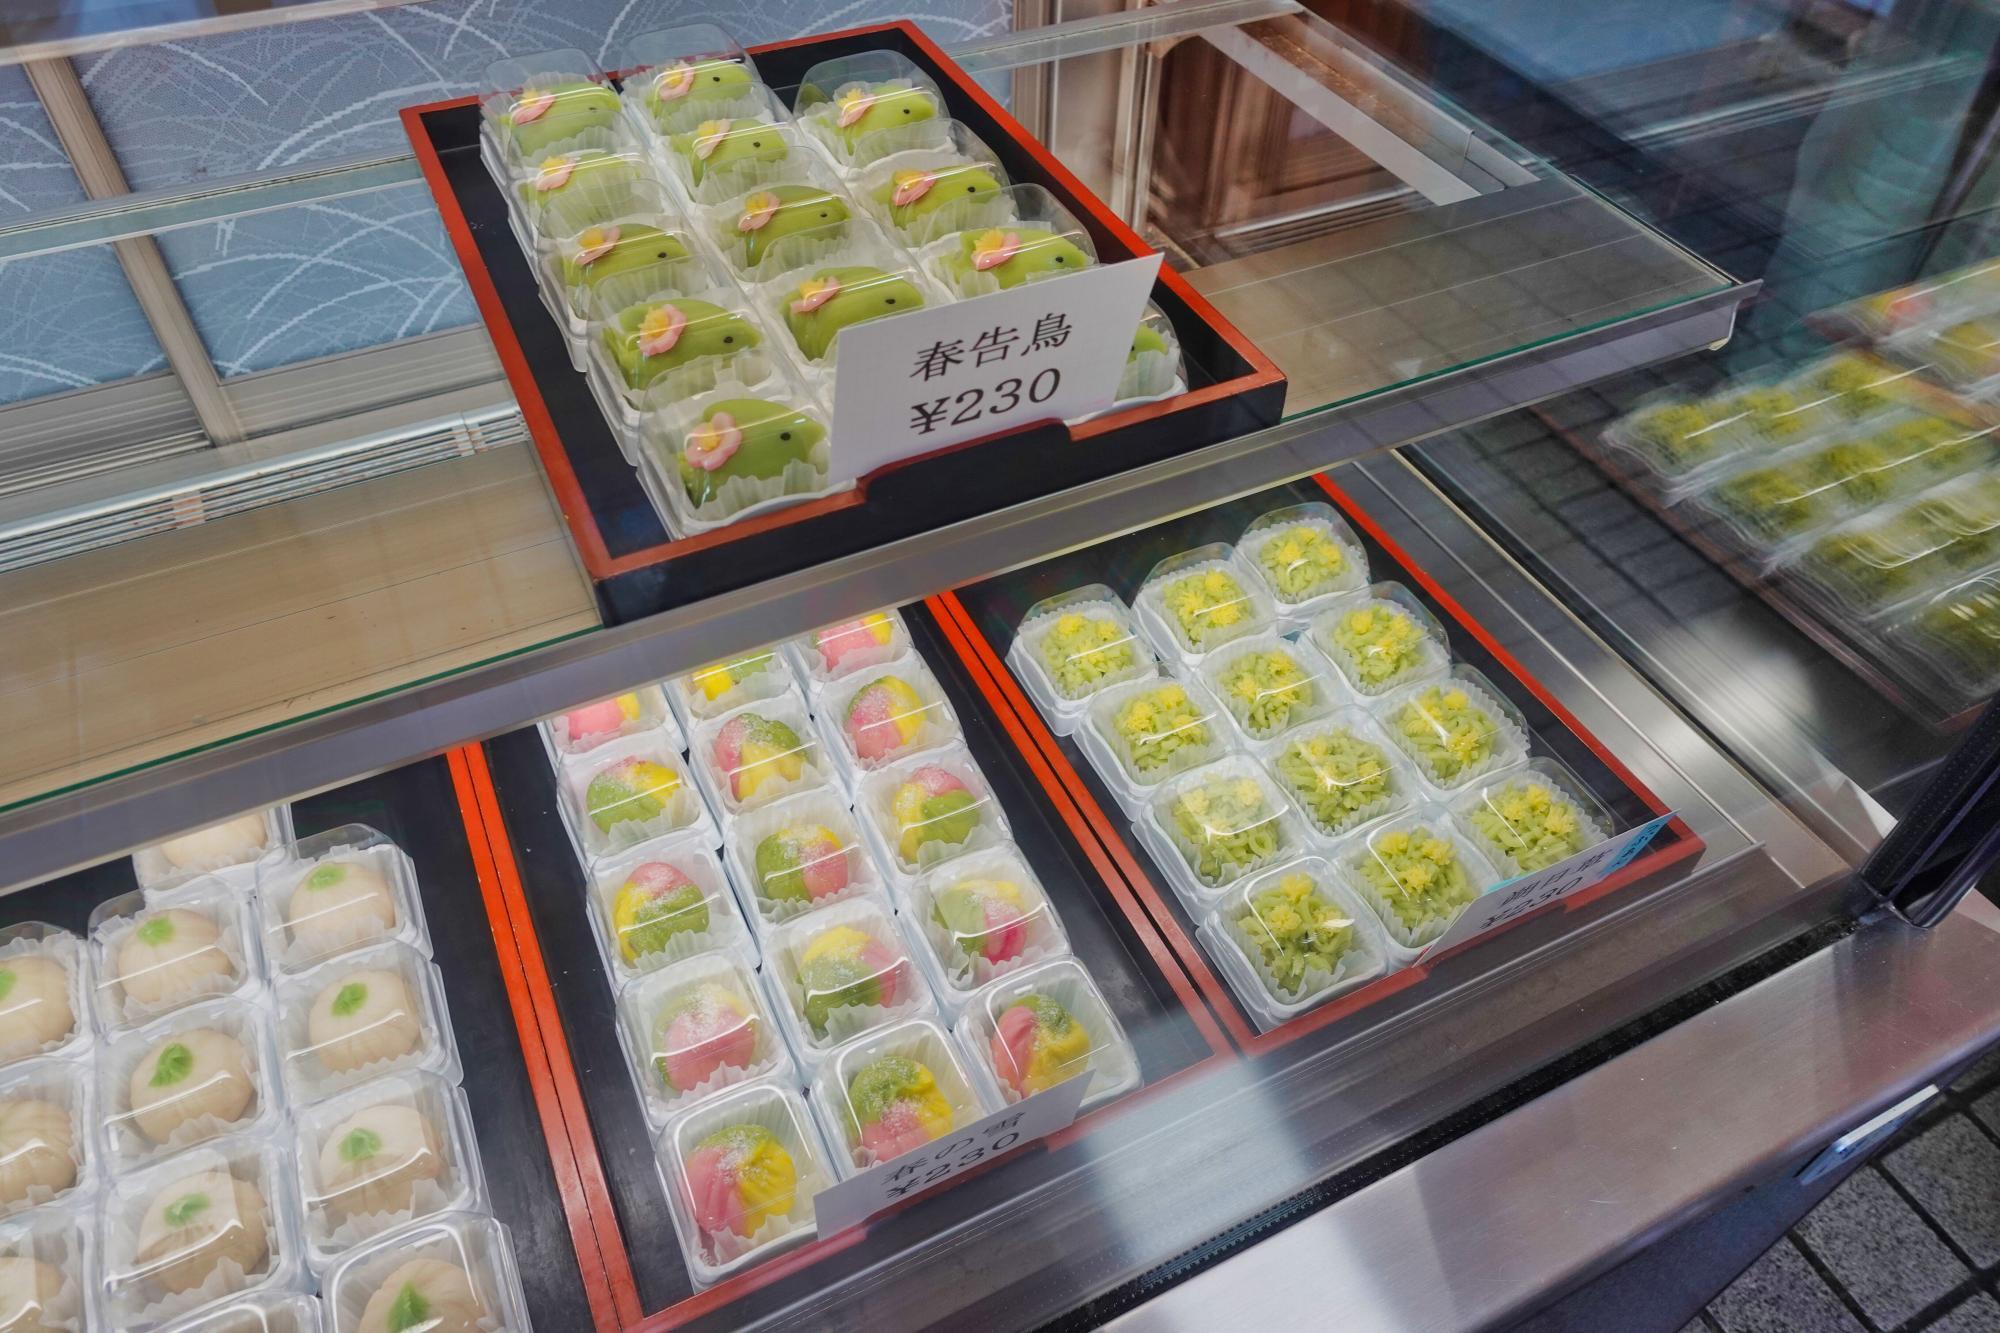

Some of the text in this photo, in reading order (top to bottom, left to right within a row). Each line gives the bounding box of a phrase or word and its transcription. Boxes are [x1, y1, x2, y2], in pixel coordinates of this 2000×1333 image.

[909, 313, 1072, 381] 春告鳥
[910, 368, 1060, 434] ¥230
[1480, 877, 1583, 929] ¥230
[887, 1132, 1020, 1198] ¥230
